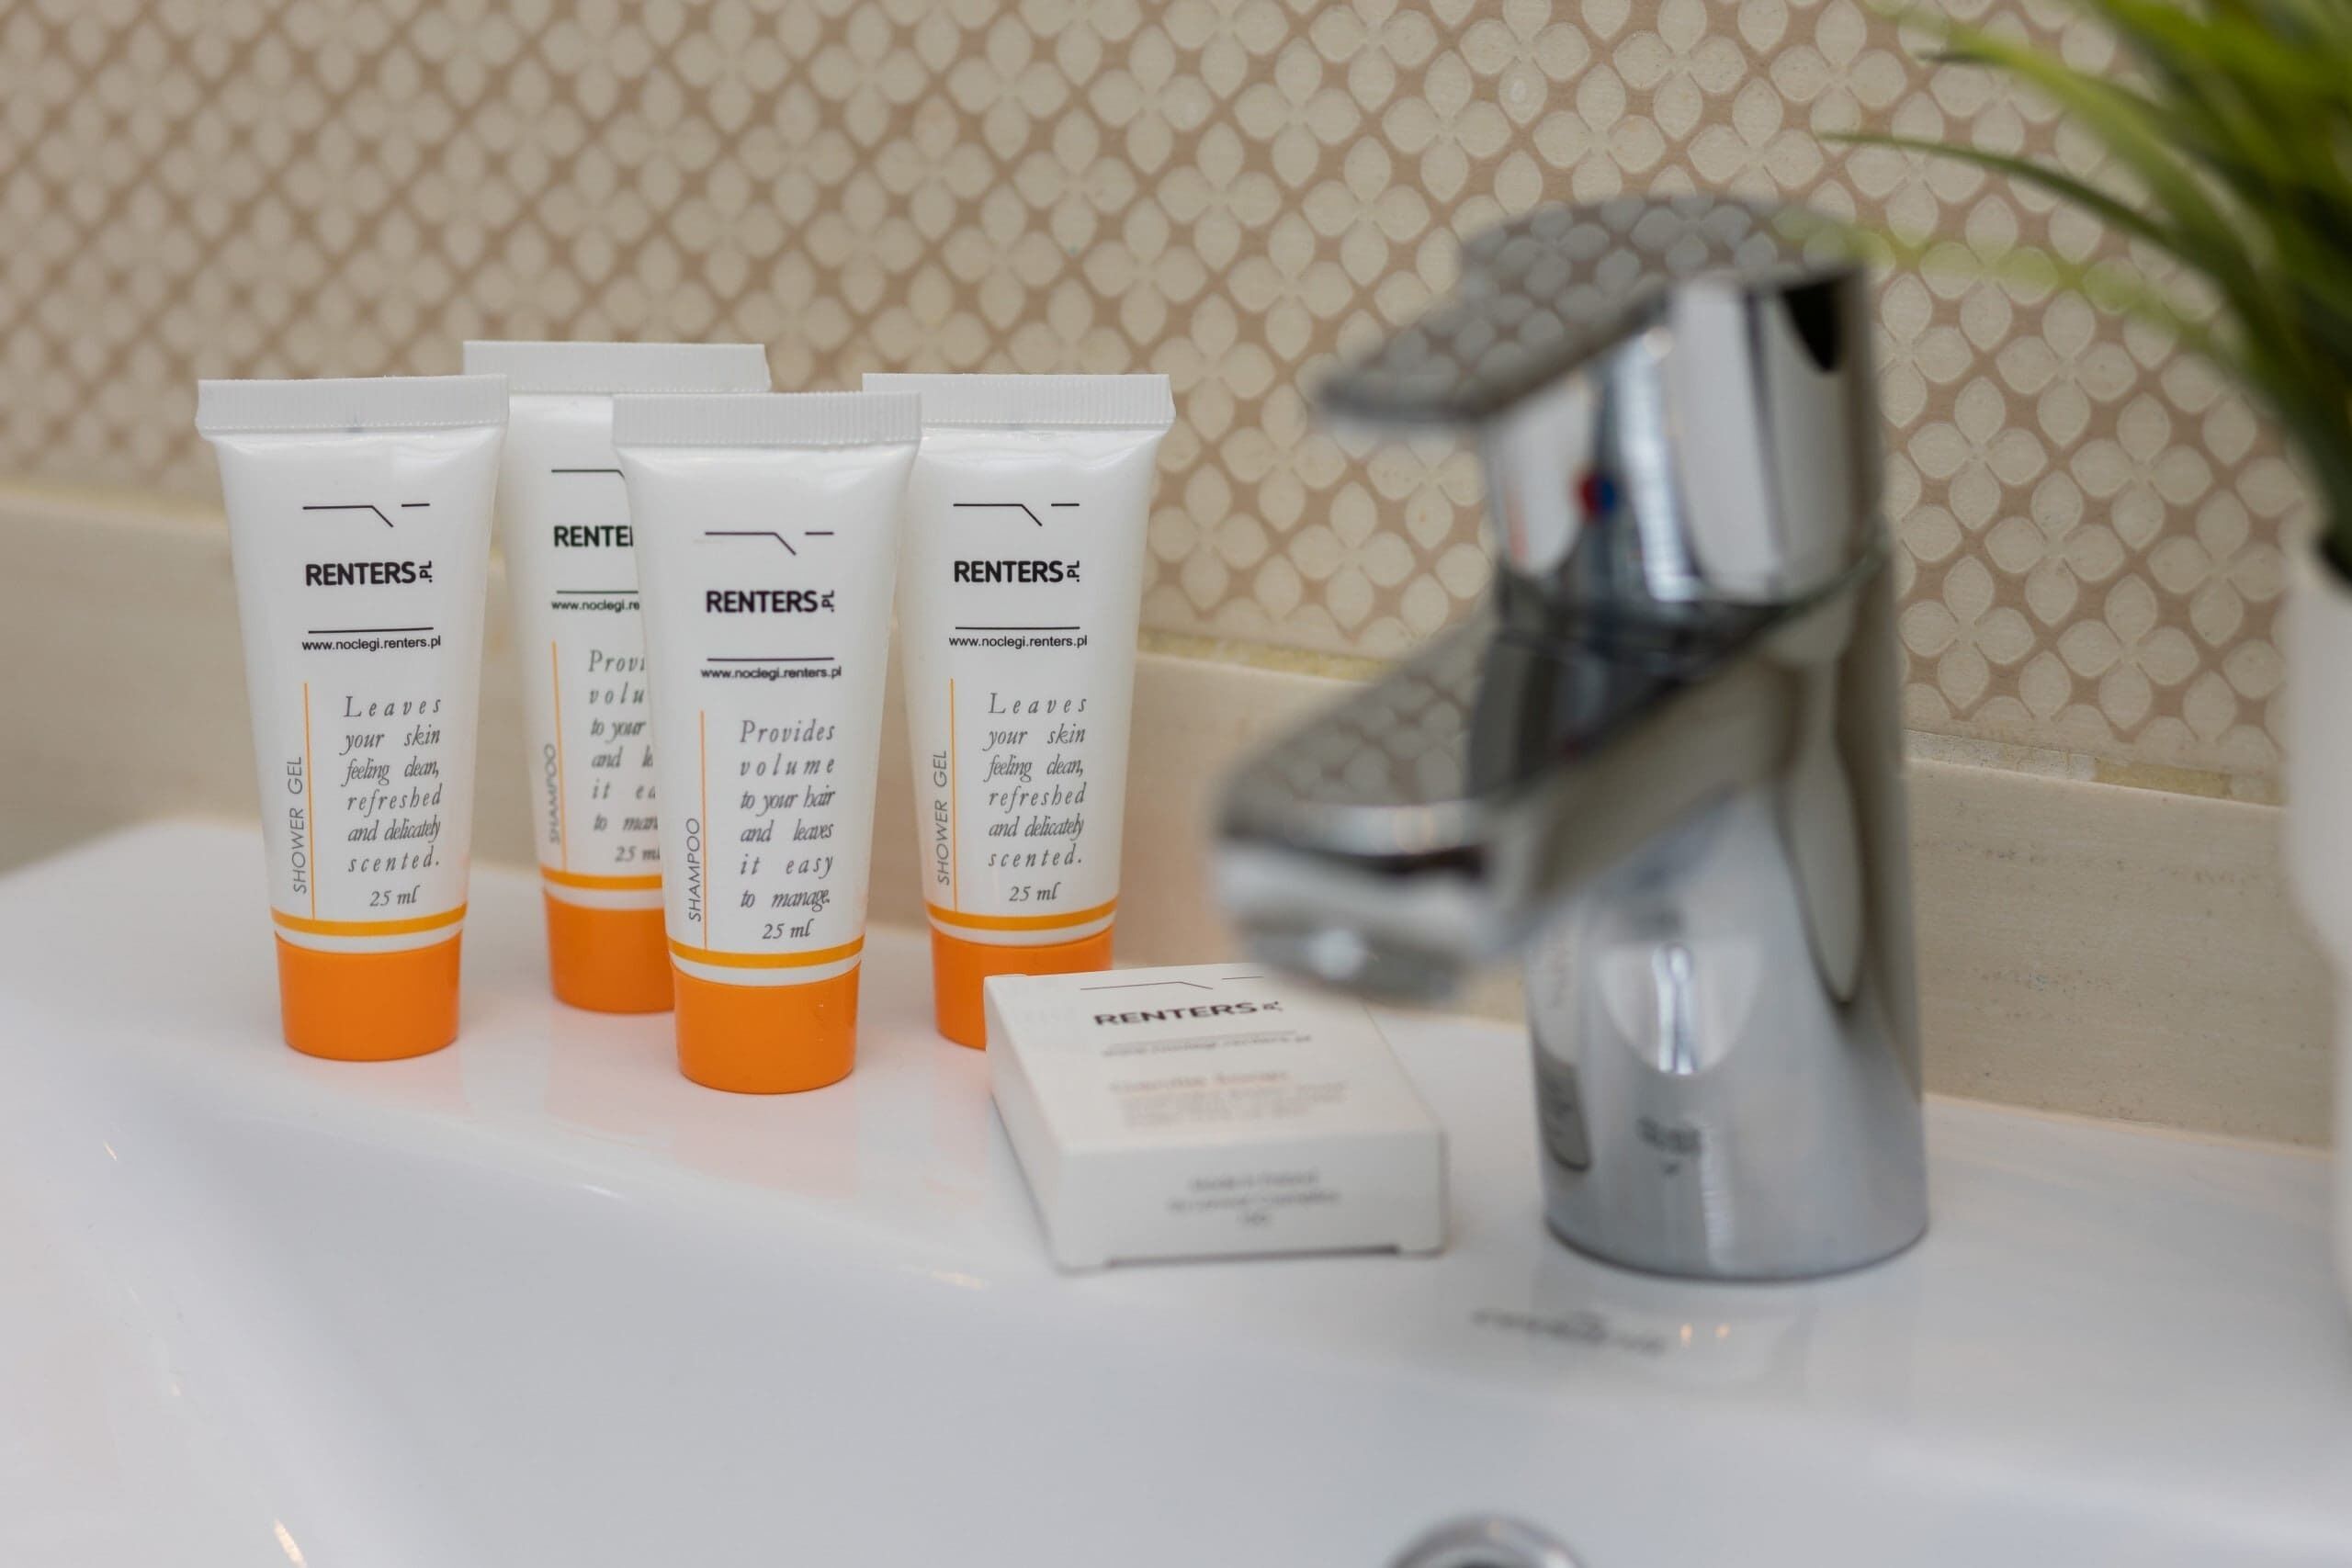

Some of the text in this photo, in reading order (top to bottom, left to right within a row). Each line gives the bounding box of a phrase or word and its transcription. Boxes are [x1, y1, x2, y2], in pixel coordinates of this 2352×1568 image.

[306, 561, 416, 586] RENTERS
[955, 560, 1063, 582] RENTERS
[551, 600, 639, 613] www.noclegi.re
[707, 590, 818, 613] RENTERS
[302, 636, 441, 651] www.noclegi.renters.pl
[949, 635, 1087, 649] www.noclegi.renters.pl
[588, 649, 645, 672] Provi
[701, 666, 842, 682] www.noclegi.renters.pl
[590, 682, 644, 705] volu
[989, 693, 1087, 714] Leaves
[344, 696, 441, 717] Leaves
[339, 724, 440, 755] your skin
[591, 718, 647, 743] to your
[740, 718, 835, 742] Provides
[982, 723, 1085, 751] your skin
[592, 746, 623, 768] and
[741, 753, 834, 776] volume
[983, 753, 1083, 783] feeling clean,
[341, 756, 439, 787] feeling clean,
[346, 783, 443, 817] refreshed
[593, 779, 655, 799] it ea
[741, 784, 836, 817] to your hair
[987, 782, 1087, 812] refreshed
[287, 757, 307, 894] SHOWER GEL
[348, 814, 441, 843] and delicately
[594, 814, 607, 831] to
[933, 750, 950, 886] SHOWER GEL
[989, 813, 1084, 841] and delicately
[741, 818, 834, 842] and leaves
[348, 845, 439, 872] scented.
[615, 846, 637, 863] 25
[741, 853, 833, 879] it easy
[989, 842, 1081, 867] scented.
[686, 818, 701, 922] SHAMPOO
[369, 885, 420, 907] 25 ml
[741, 889, 830, 912] to manage.
[1009, 882, 1061, 901] 25 ml
[763, 919, 814, 939] 25 ml
